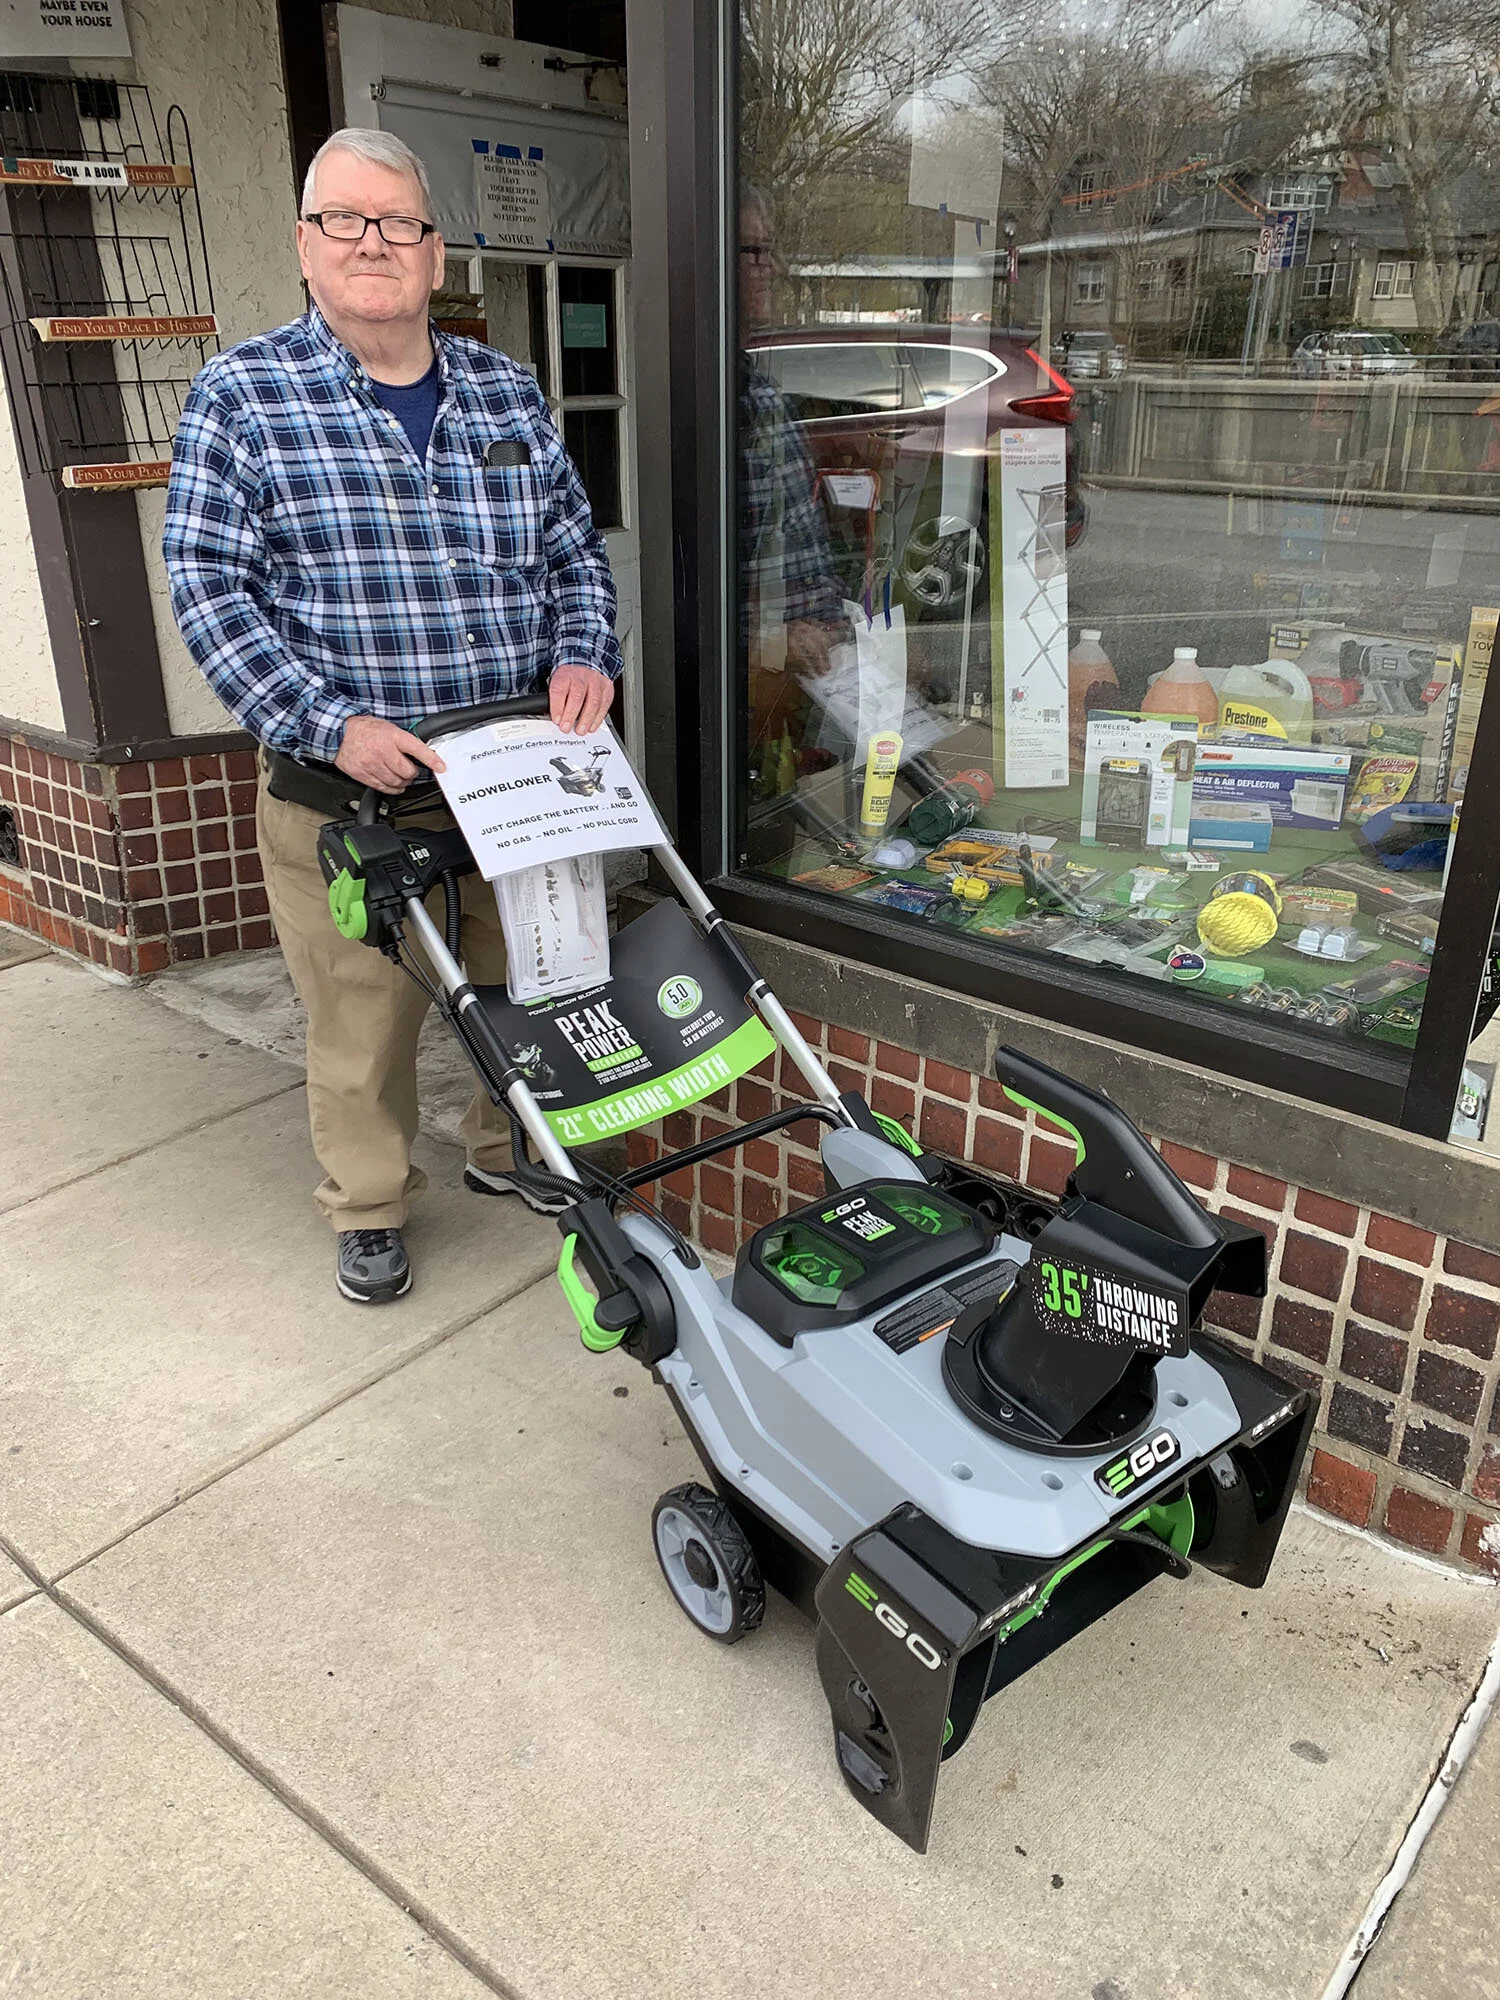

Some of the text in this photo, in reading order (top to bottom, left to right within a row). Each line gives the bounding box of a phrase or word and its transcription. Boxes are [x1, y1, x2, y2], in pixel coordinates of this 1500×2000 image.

[40, 0, 109, 12] MAYBE EVEN
[41, 14, 112, 27] YOUR HOUSE
[84, 166, 92, 178] A
[94, 166, 122, 178] BOOK
[498, 232, 535, 245] NOTICE!
[54, 321, 82, 335] FIND
[84, 320, 116, 334] YOUR
[118, 320, 151, 333] PLACE
[170, 318, 213, 332] HISTORY
[76, 469, 103, 481] FIND
[104, 468, 138, 481] YOUR
[1225, 708, 1268, 728] Prestone
[470, 738, 587, 762] Reduce Your Carbon Footprint
[458, 774, 552, 805] SNOWBLOWER
[1193, 776, 1214, 786] HEAT
[1222, 777, 1236, 787] AIR
[1237, 778, 1280, 790] DEFLECTOR
[480, 824, 504, 836] JUST
[506, 814, 543, 832] CHARGE
[544, 810, 562, 821] THE
[563, 804, 600, 817] BATTERY
[610, 801, 627, 810] AND
[627, 800, 638, 808] GO
[497, 840, 512, 850] NO
[513, 834, 532, 846] GAS
[543, 828, 556, 838] NO
[558, 825, 573, 835] OIL
[583, 821, 595, 830] NO
[596, 818, 616, 828] PULL
[618, 816, 638, 826] CORD
[410, 848, 430, 861] 180
[667, 983, 688, 1004] 5.0
[680, 1018, 704, 1037] INCLUDES
[698, 1016, 724, 1038] BATTERIES
[572, 1026, 637, 1062] POWER
[557, 1054, 732, 1140] 21" CLEARING WIDTH
[821, 1197, 867, 1223] EGO
[842, 1210, 880, 1232] PEAK
[855, 1219, 892, 1239] POWER
[1042, 1262, 1088, 1319] 35'
[1093, 1277, 1178, 1326] THROWING
[1096, 1303, 1172, 1350] DISTANCE
[1106, 1432, 1176, 1496] EGO
[845, 1572, 942, 1671] EGO
